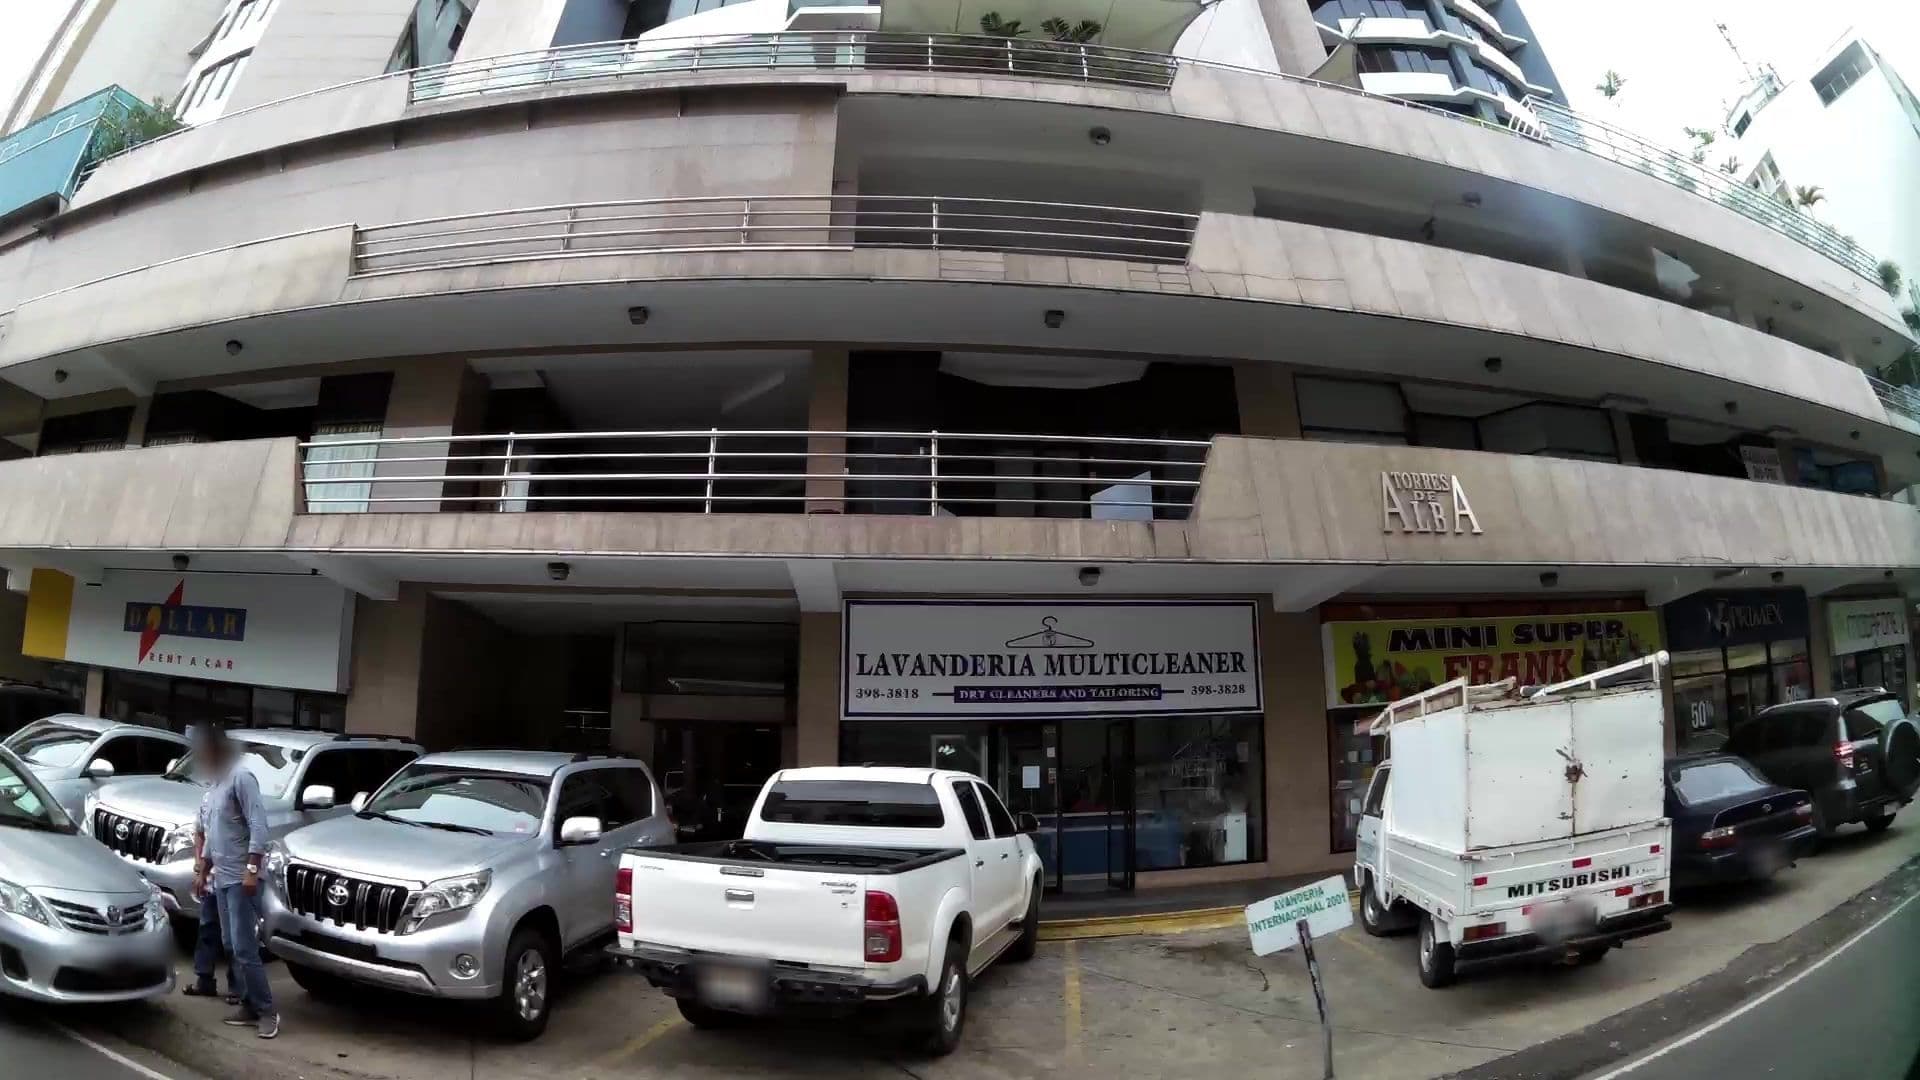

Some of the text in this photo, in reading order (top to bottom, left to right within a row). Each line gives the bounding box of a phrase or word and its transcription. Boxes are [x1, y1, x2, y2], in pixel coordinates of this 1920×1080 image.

[1390, 471, 1451, 491] TORRES
[1381, 471, 1484, 535] ALBA
[1411, 490, 1437, 501] DE
[129, 604, 238, 635] DOLLAR
[1388, 619, 1625, 653] MINI SUPER
[149, 651, 234, 670] RENT A CAR
[856, 651, 1248, 678] LAVANDERIA MULTICLEANER
[1443, 647, 1575, 686] FRANK
[856, 687, 919, 700] 398-3818
[959, 687, 1159, 699] DRY CLEANERS AND TAILORING
[1191, 683, 1246, 697] 398-3828
[1507, 865, 1631, 898] MITSUBISHI
[1273, 886, 1325, 912] AVANDERIA
[1251, 892, 1347, 934] INTERNACIONAL 2001
